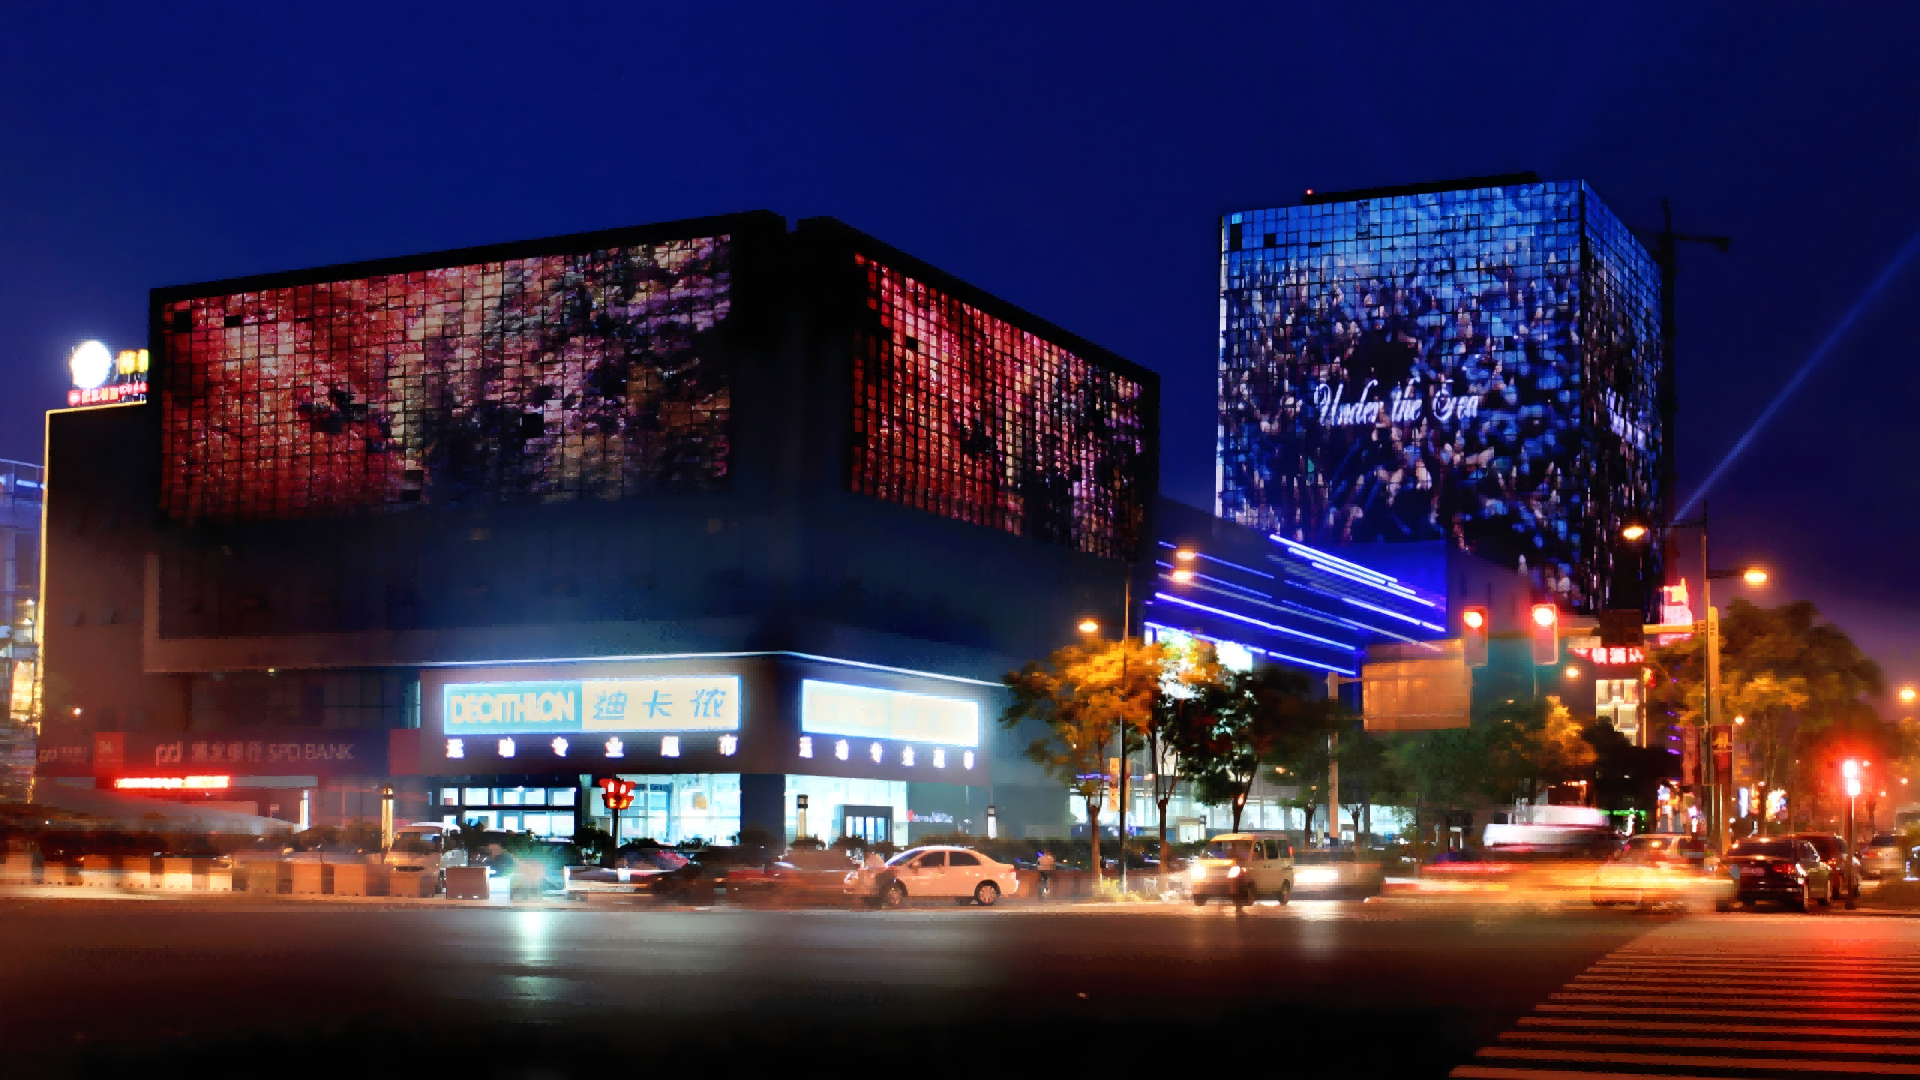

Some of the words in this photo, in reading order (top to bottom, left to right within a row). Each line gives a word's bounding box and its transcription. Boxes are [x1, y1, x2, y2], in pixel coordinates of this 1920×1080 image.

[1314, 379, 1384, 426] Under
[1390, 376, 1422, 422] the
[450, 691, 575, 724] DECATHLON
